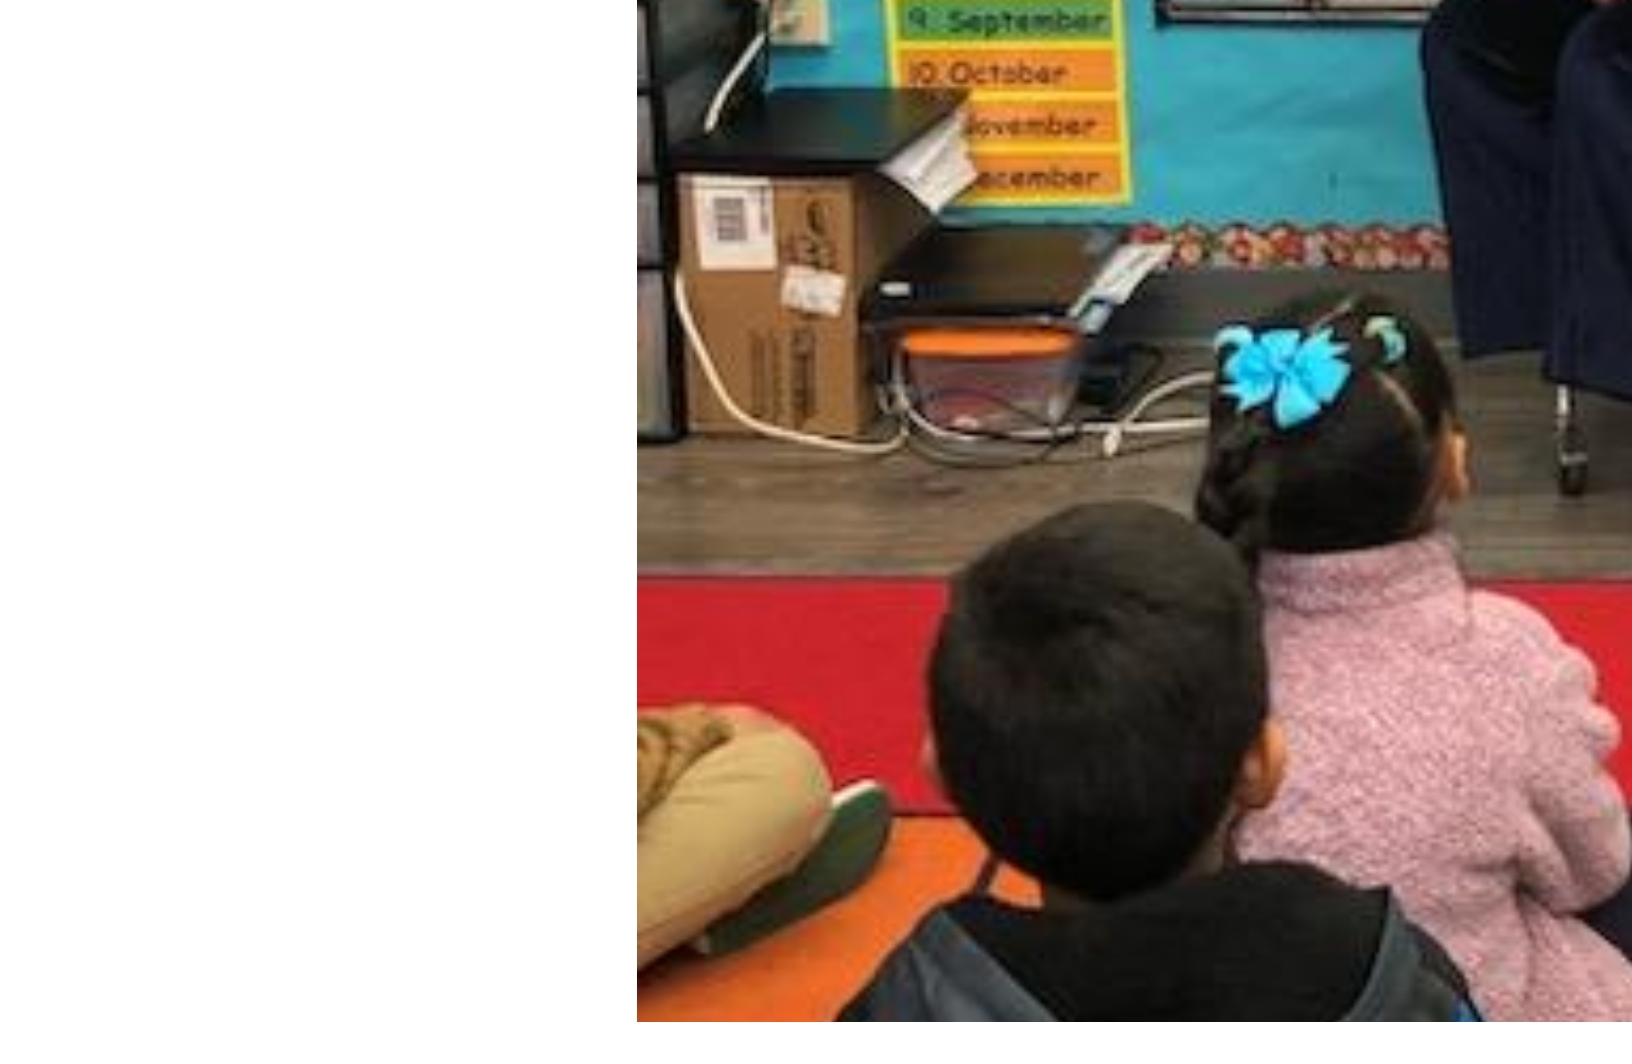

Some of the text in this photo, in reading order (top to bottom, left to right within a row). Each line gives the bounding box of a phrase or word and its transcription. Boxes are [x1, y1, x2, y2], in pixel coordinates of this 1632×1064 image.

[948, 9, 1111, 38] September
[949, 61, 1069, 85] October
[976, 166, 1102, 189] ecember
